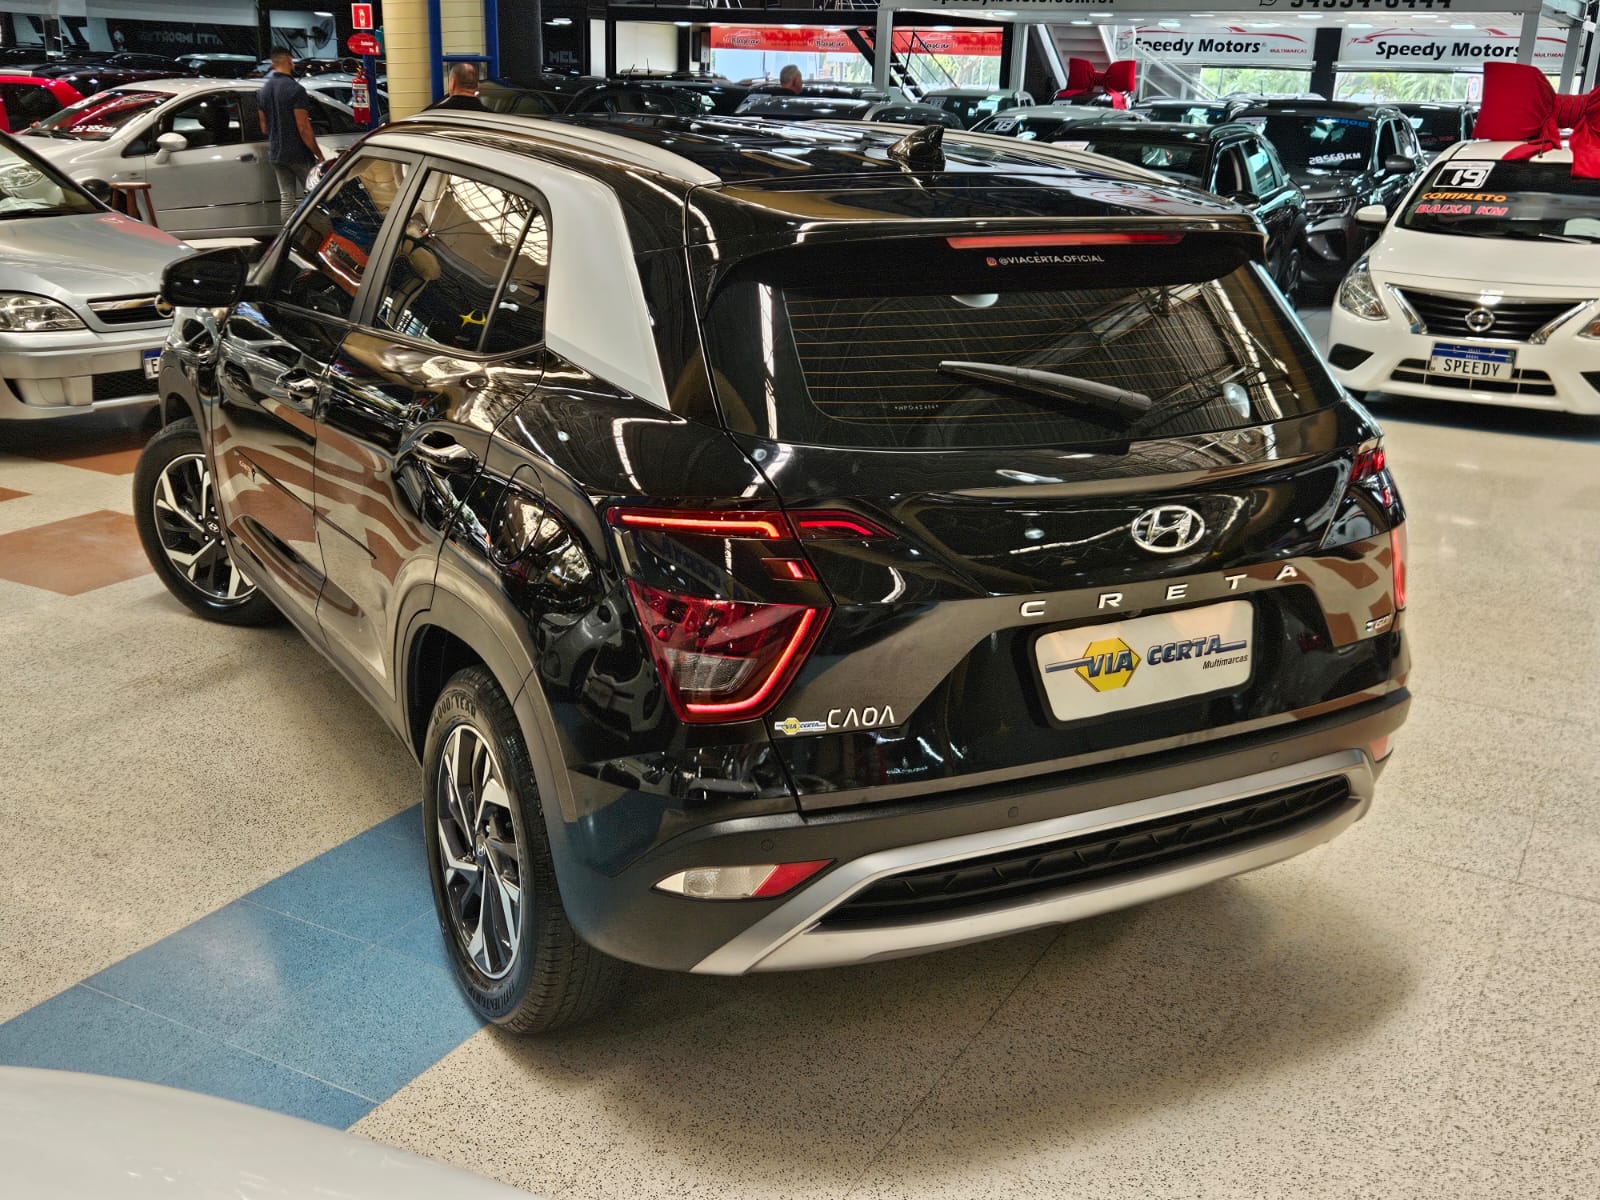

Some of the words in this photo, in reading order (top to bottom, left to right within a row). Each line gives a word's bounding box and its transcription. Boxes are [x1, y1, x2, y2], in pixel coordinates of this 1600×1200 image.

[1198, 38, 1262, 53] Motors
[1376, 41, 1447, 60] Speedy
[1451, 169, 1487, 186] 19
[1421, 192, 1507, 202] COMPLETO
[1415, 204, 1472, 214] BAIXA
[1475, 205, 1509, 216] KM
[998, 254, 1105, 266] @VIACERTA.OFICIAL
[1443, 358, 1500, 377] SPEEDY
[1019, 564, 1299, 617] CRETA
[1087, 650, 1135, 678] VIA
[1147, 634, 1221, 666] CERTA
[1202, 654, 1249, 670] Multimarcas
